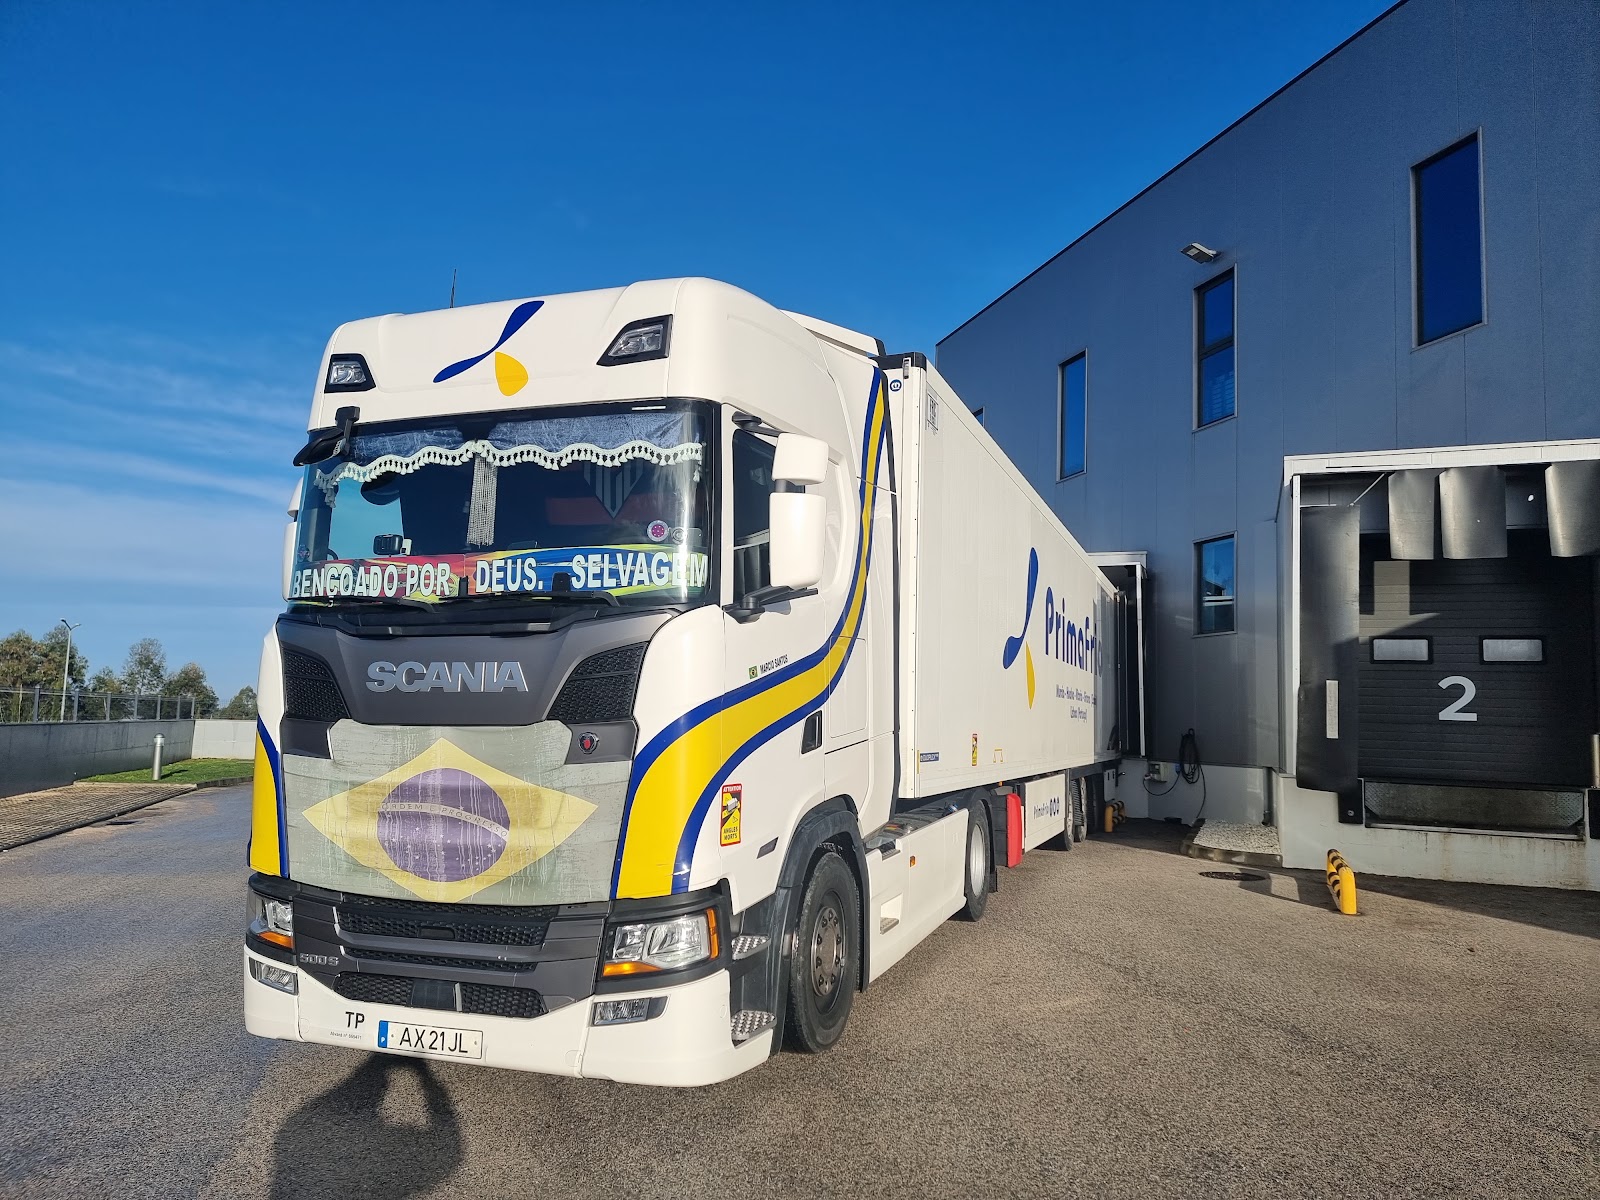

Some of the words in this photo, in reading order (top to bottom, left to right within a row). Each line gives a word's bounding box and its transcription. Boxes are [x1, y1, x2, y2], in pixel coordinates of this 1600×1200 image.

[405, 562, 450, 597] POR
[475, 556, 544, 593] DEUS.
[571, 551, 708, 589] SELVAGEM
[365, 661, 529, 693] SCANIA
[1437, 675, 1478, 722] 2
[723, 785, 742, 793] ATTENTION
[441, 807, 508, 837] PROGRESSO
[723, 826, 739, 834] ANGLES
[723, 832, 738, 841] MORTS
[344, 1011, 366, 1029] TP
